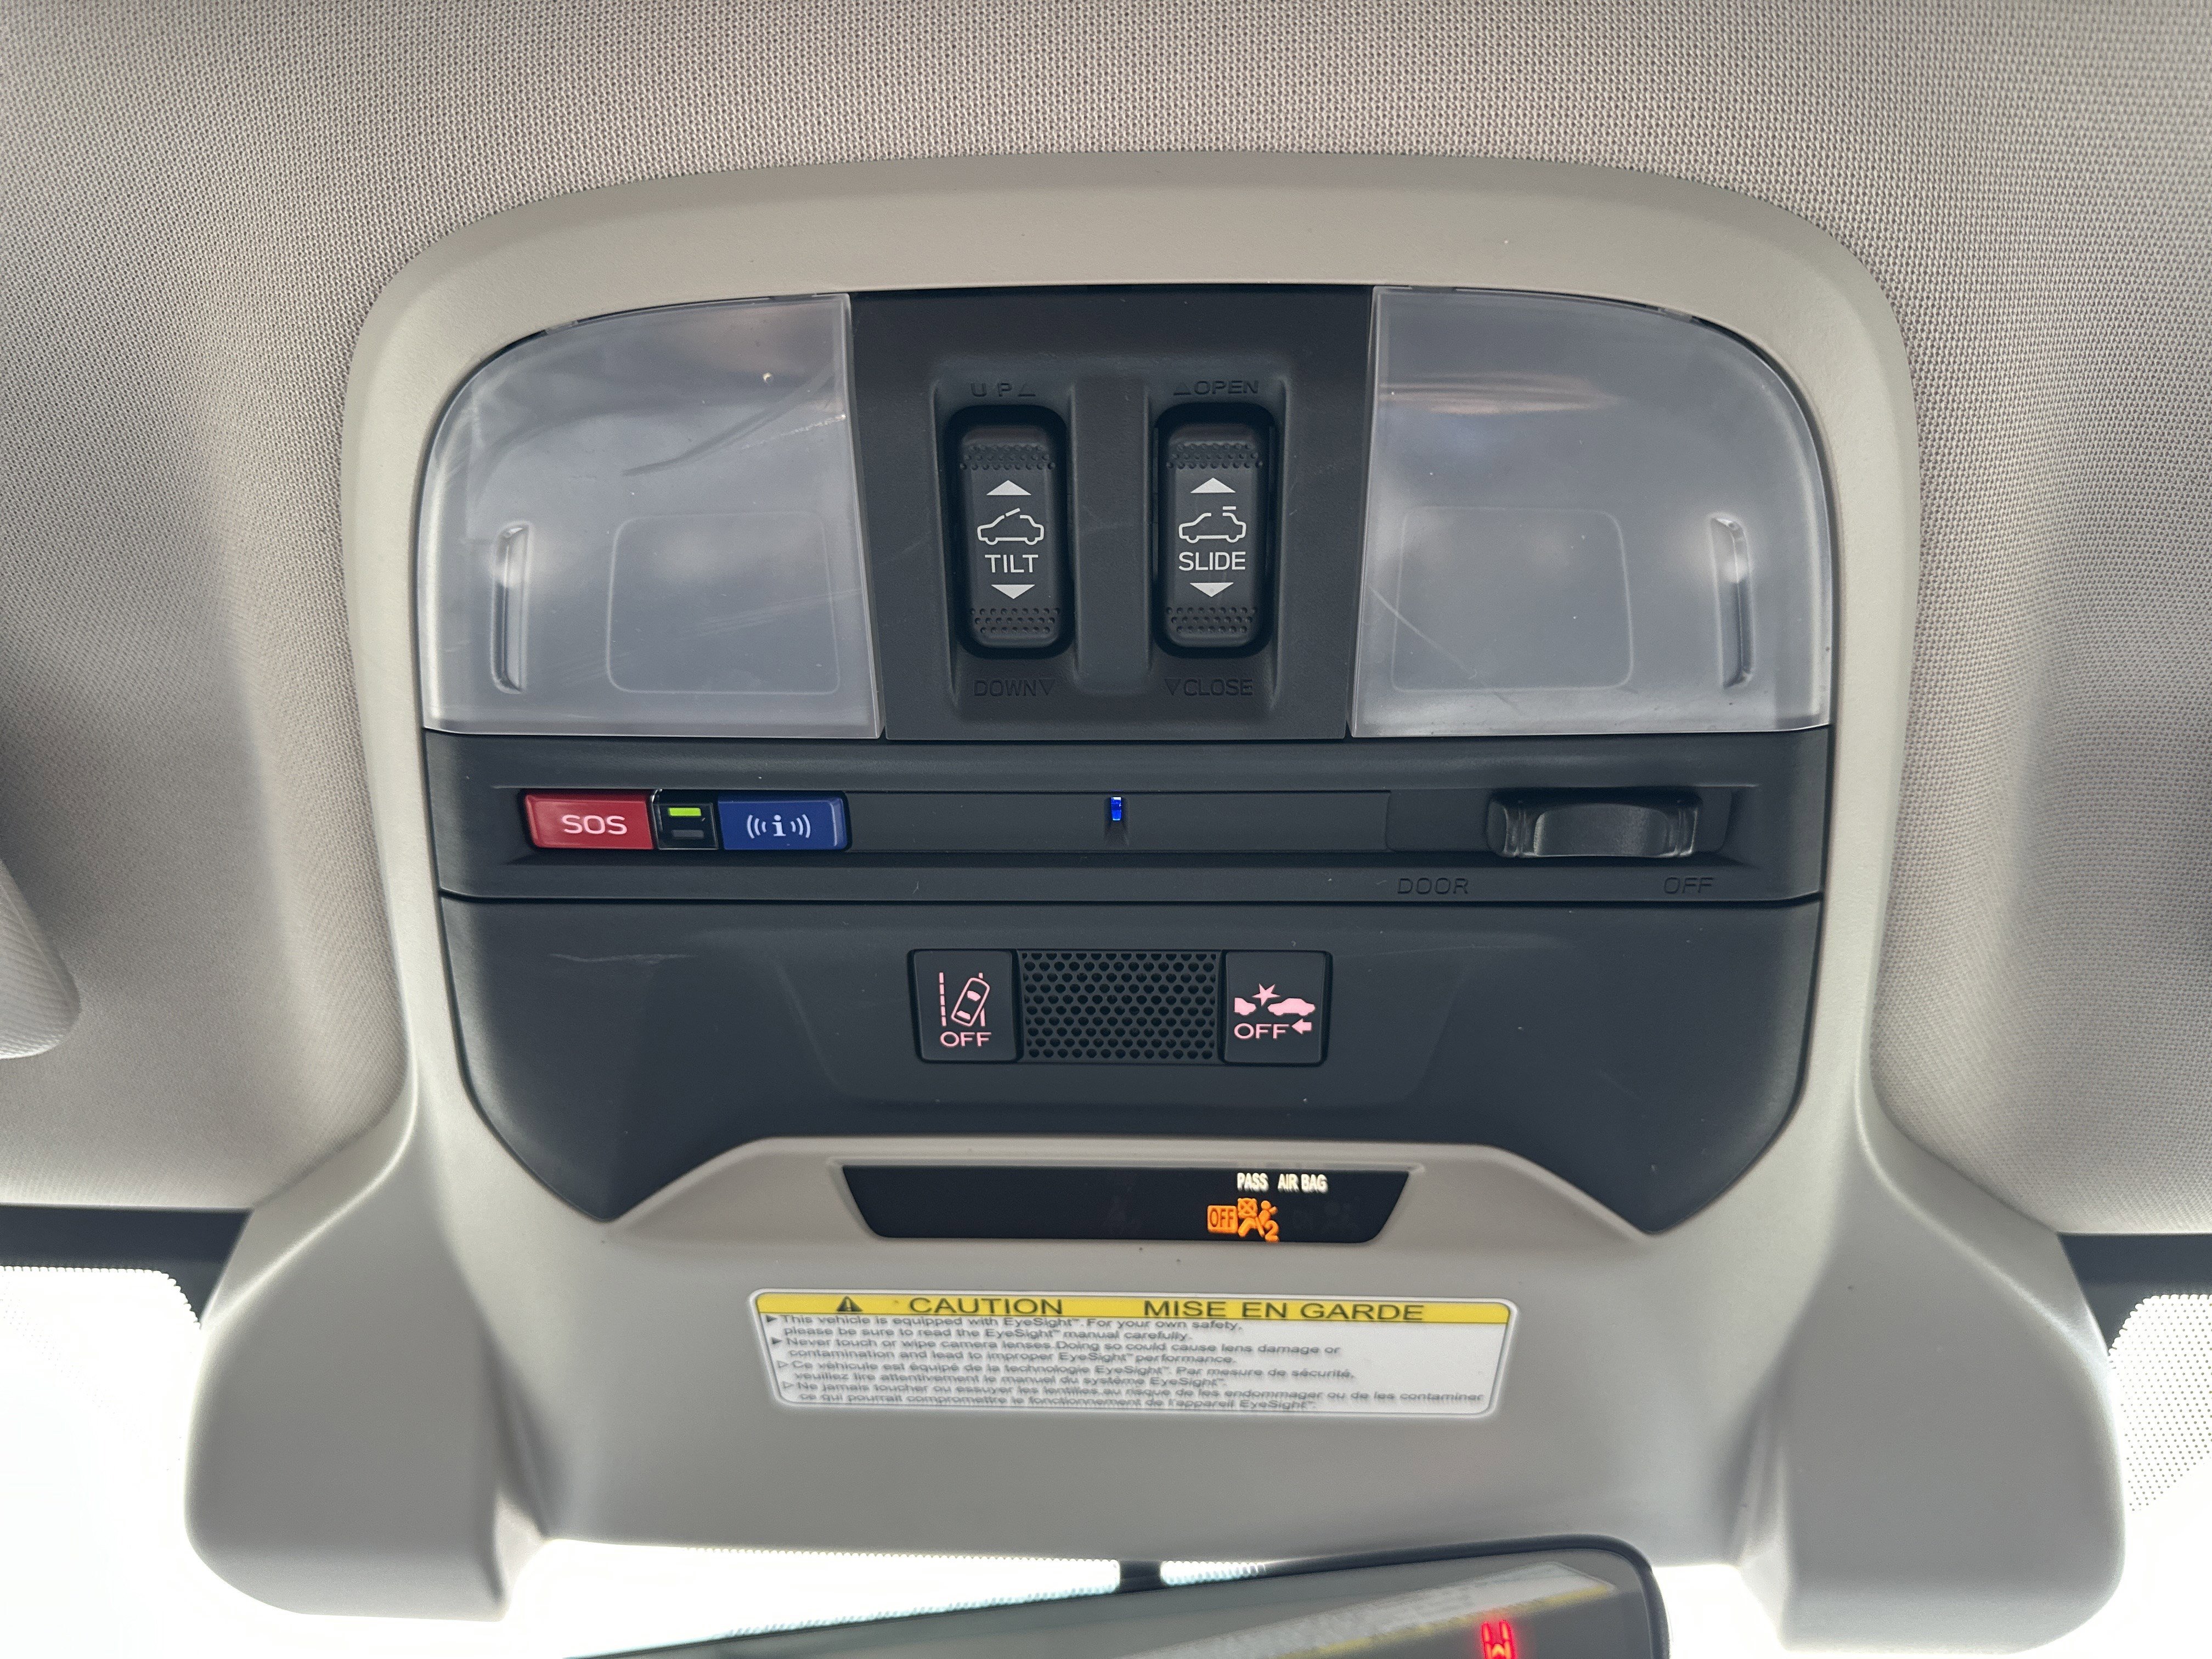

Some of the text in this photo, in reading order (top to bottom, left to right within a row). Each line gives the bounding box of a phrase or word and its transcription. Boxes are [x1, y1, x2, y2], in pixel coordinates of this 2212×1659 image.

[1194, 380, 1259, 395] OPEN
[985, 555, 1039, 573] TILT
[1178, 551, 1246, 571] SLIDE
[974, 679, 1036, 697] DOWN
[1183, 679, 1253, 697] CLOSE
[562, 815, 628, 835] SOS
[1397, 878, 1469, 894] DOOR
[1664, 877, 1713, 894] OFF
[940, 1031, 992, 1047] OFF
[1233, 1022, 1290, 1039] OFF
[1237, 1172, 1328, 1193] PASS AIR BAG
[1210, 1208, 1233, 1227] OFF
[910, 1297, 1063, 1314] CAUTION
[1144, 1300, 1424, 1321] MISE EN GARDE
[783, 1314, 812, 1324] This
[818, 1315, 871, 1325] vehicle
[877, 1316, 888, 1325] is
[893, 1316, 962, 1326] equipped
[968, 1317, 998, 1325] with
[1118, 1320, 1150, 1328] your
[785, 1327, 833, 1336] please
[838, 1327, 857, 1335] be
[787, 1338, 829, 1346] Never
[904, 1339, 936, 1348] wipe
[940, 1340, 997, 1348] camera
[1221, 1344, 1252, 1352] lens
[1258, 1345, 1319, 1355] damage
[789, 1349, 895, 1358] contamination
[933, 1351, 963, 1359] lead
[987, 1351, 1054, 1361] improper
[1268, 1368, 1286, 1376] de
